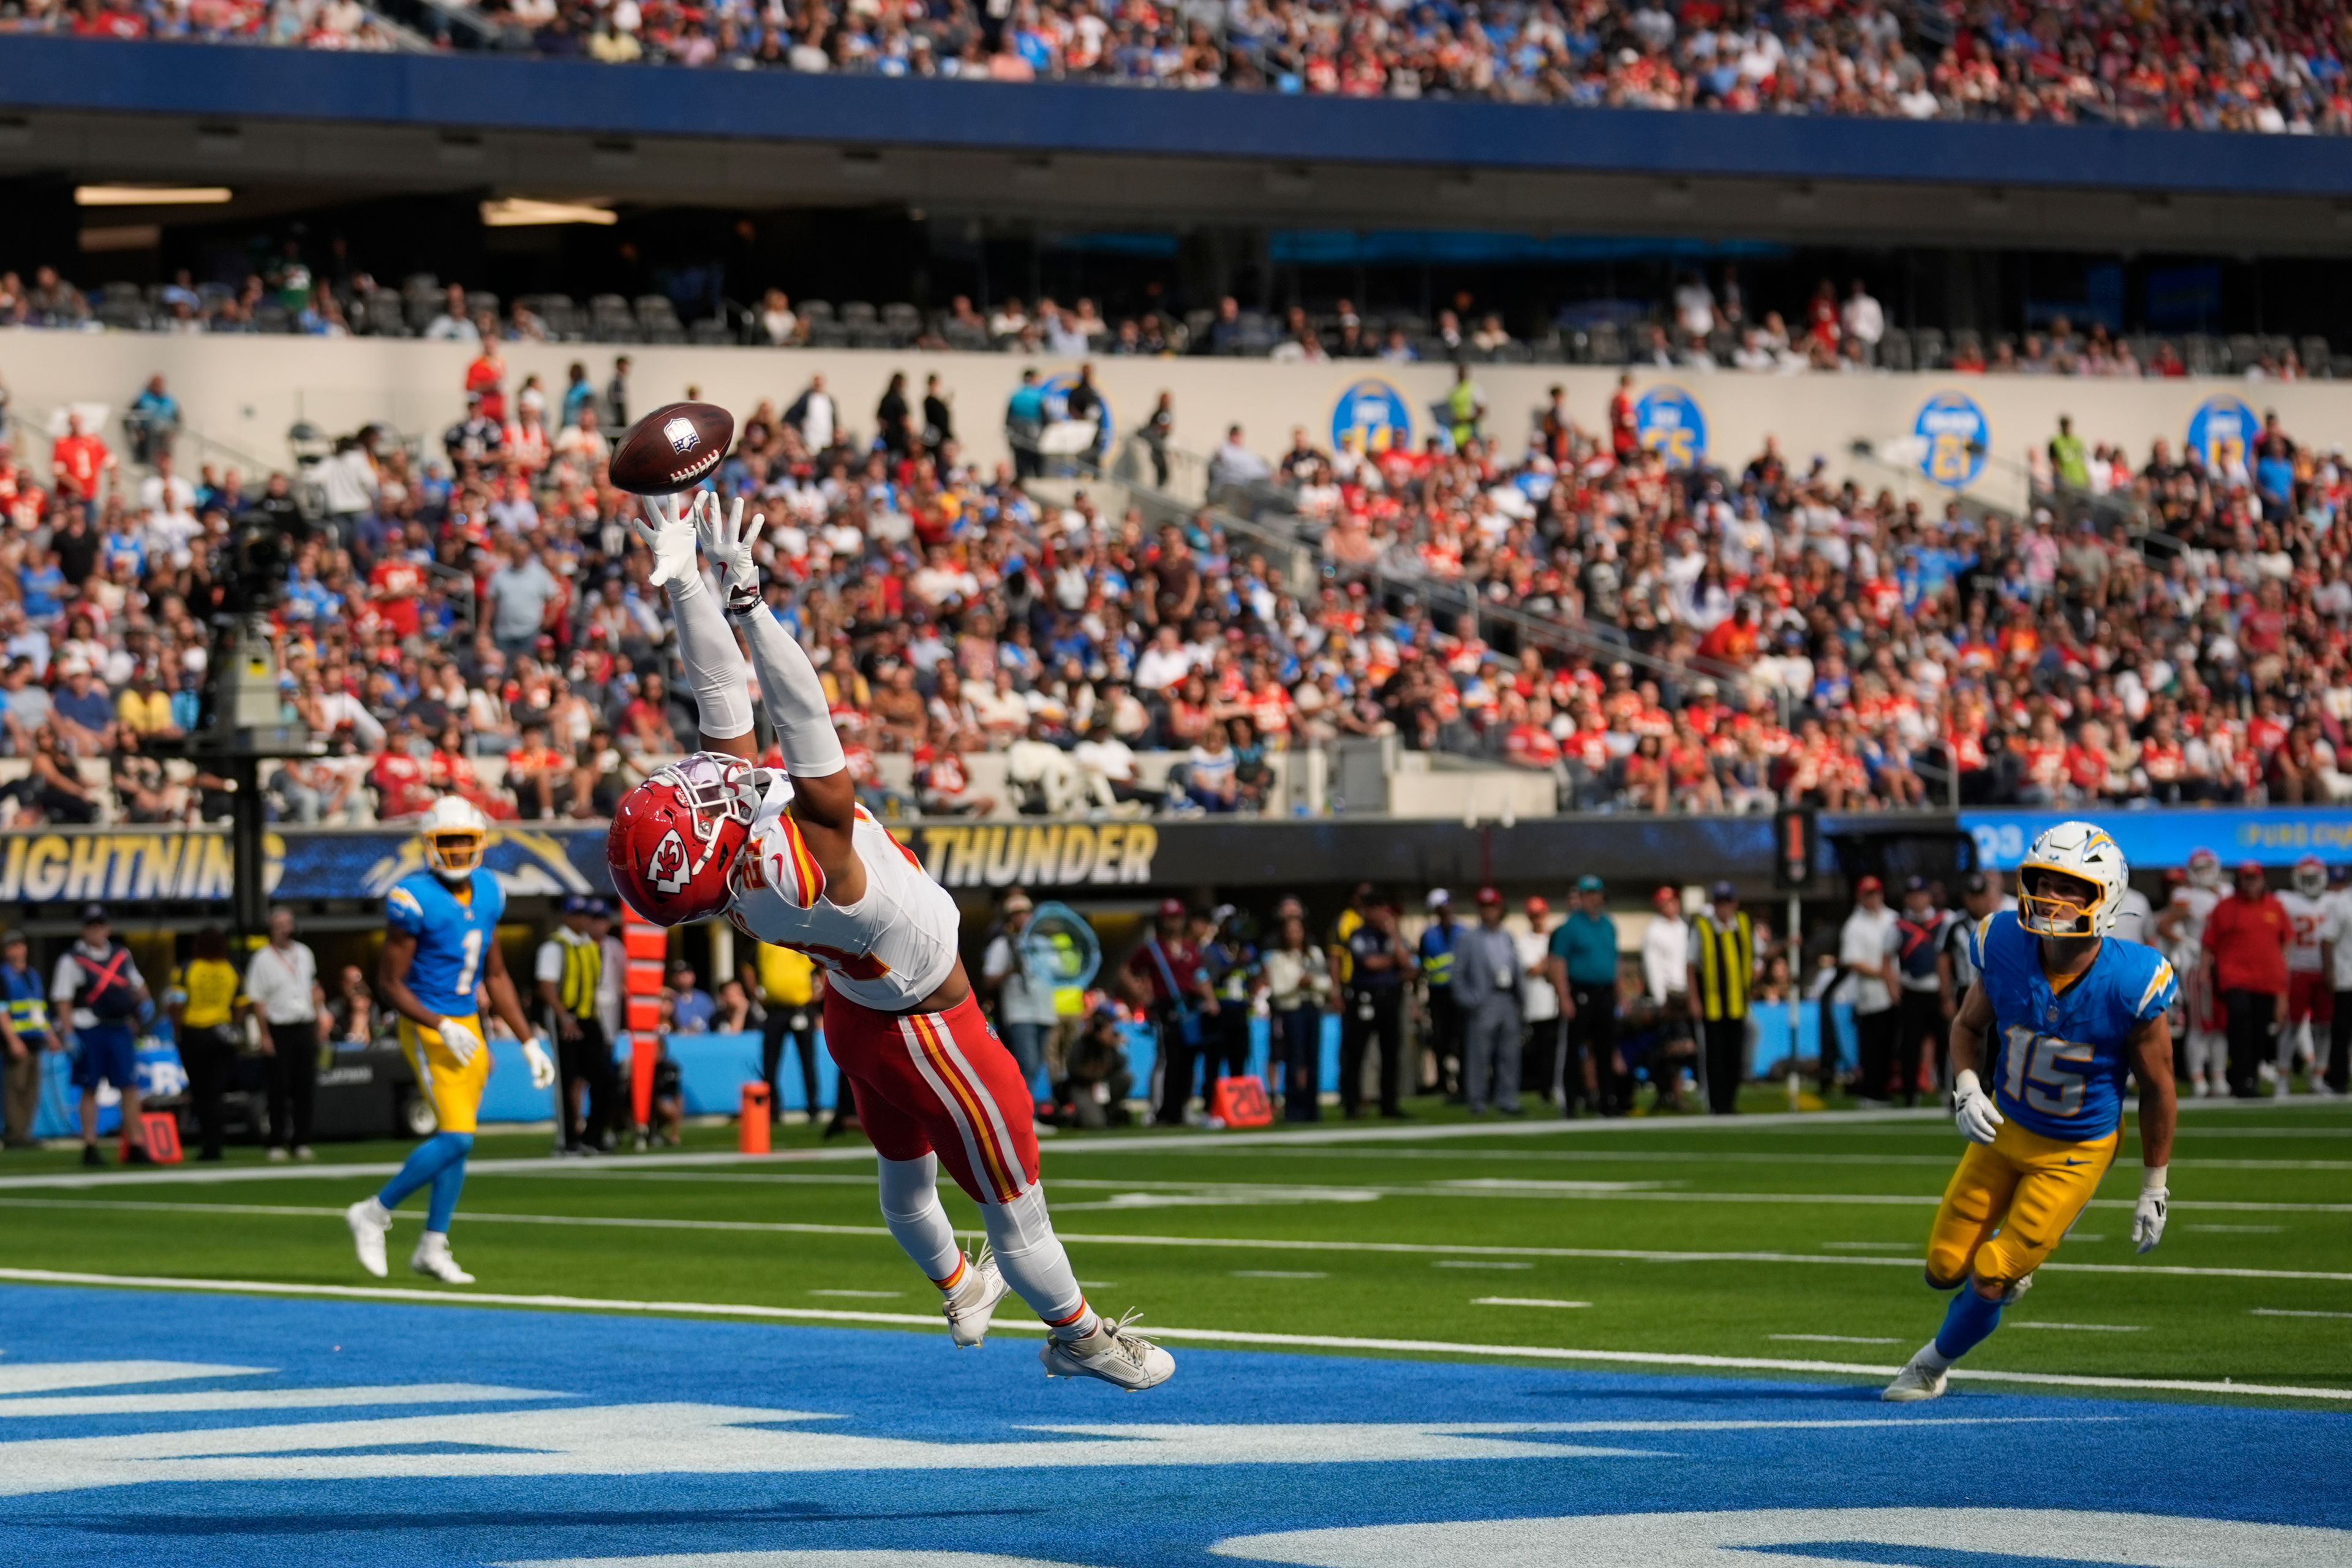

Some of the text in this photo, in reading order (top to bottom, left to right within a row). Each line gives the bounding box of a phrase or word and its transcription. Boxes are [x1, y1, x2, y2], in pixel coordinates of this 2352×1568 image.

[0, 834, 286, 902] IGHTNIN
[656, 840, 684, 882] KC
[922, 824, 1158, 887] THUNDER
[455, 929, 482, 995] 1
[2003, 1023, 2096, 1117] 15
